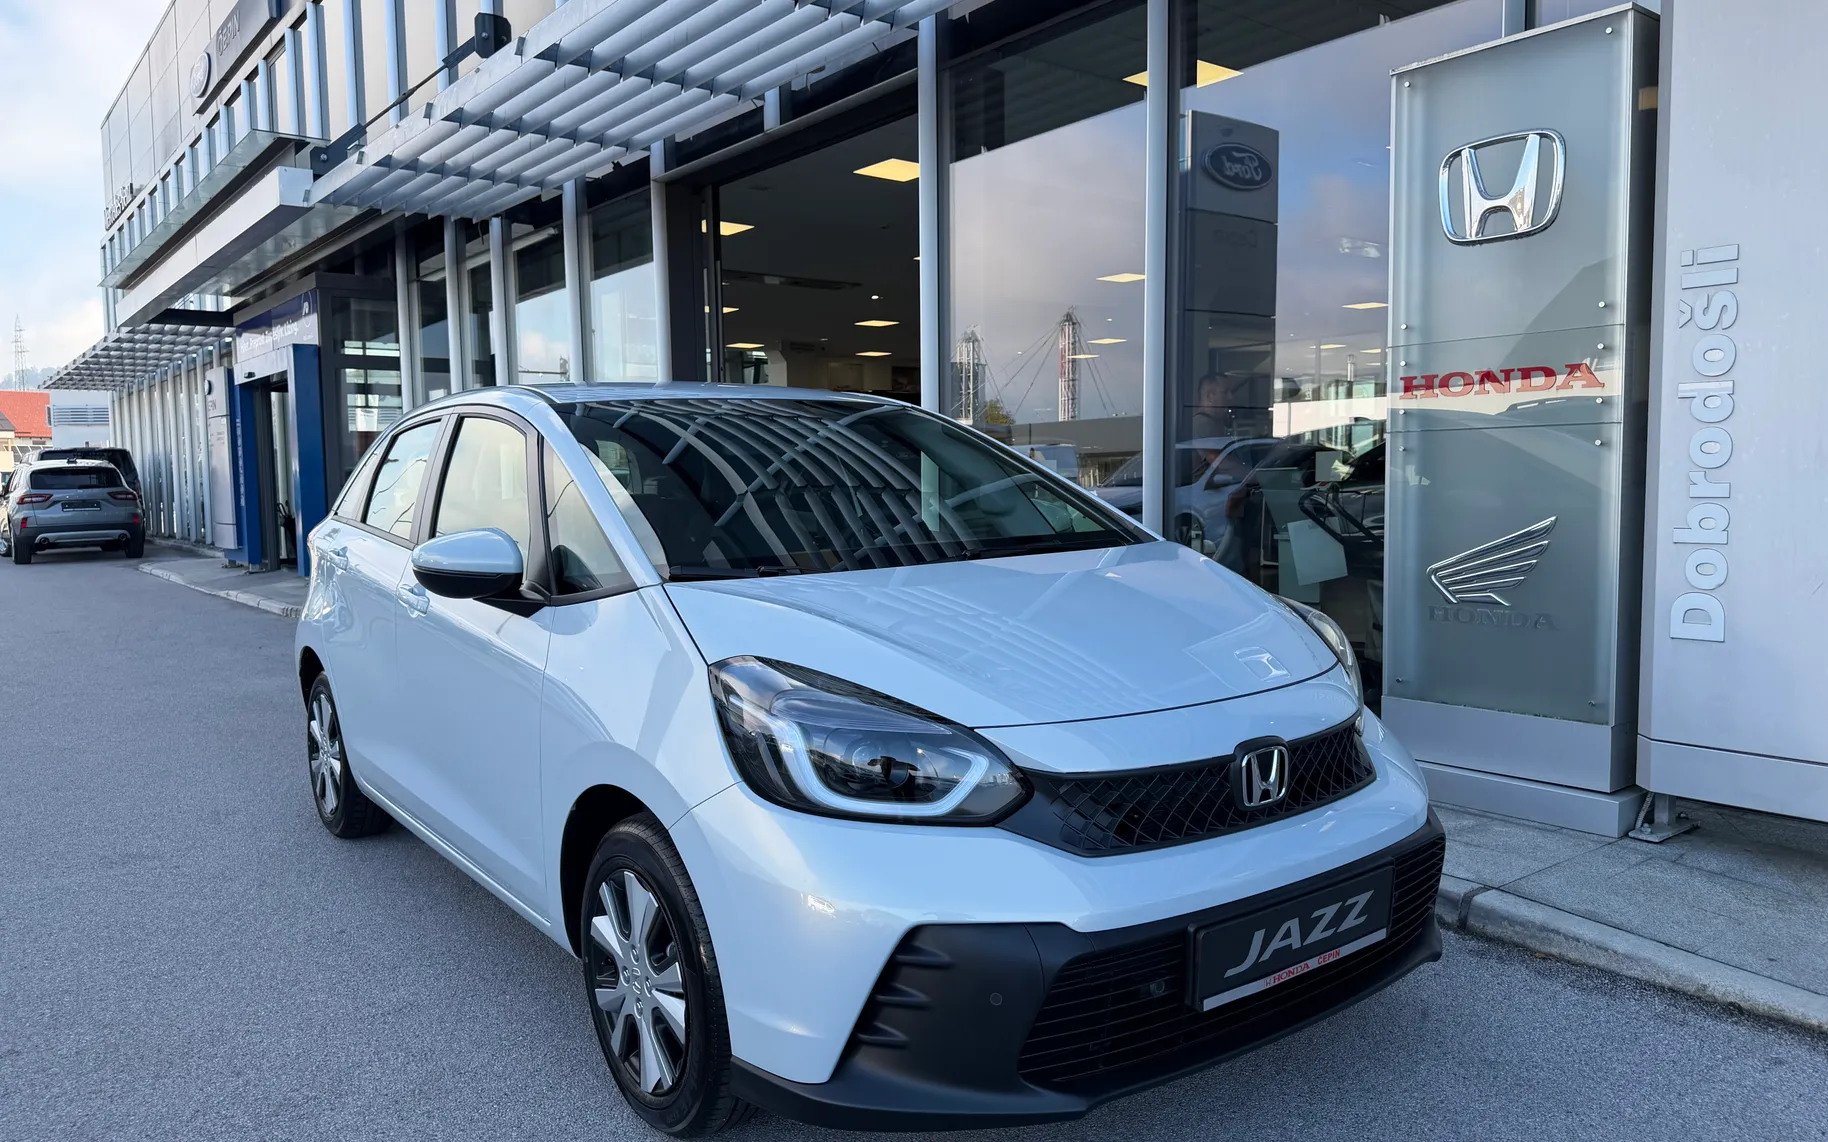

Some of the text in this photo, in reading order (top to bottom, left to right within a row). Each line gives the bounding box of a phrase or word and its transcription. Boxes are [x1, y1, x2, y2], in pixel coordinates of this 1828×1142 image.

[1399, 362, 1606, 400] HONDA
[1669, 243, 1740, 643] Dobrodošli
[1428, 604, 1560, 631] HONDA
[1223, 889, 1375, 979] JAZZ
[1272, 962, 1311, 984] HONDA
